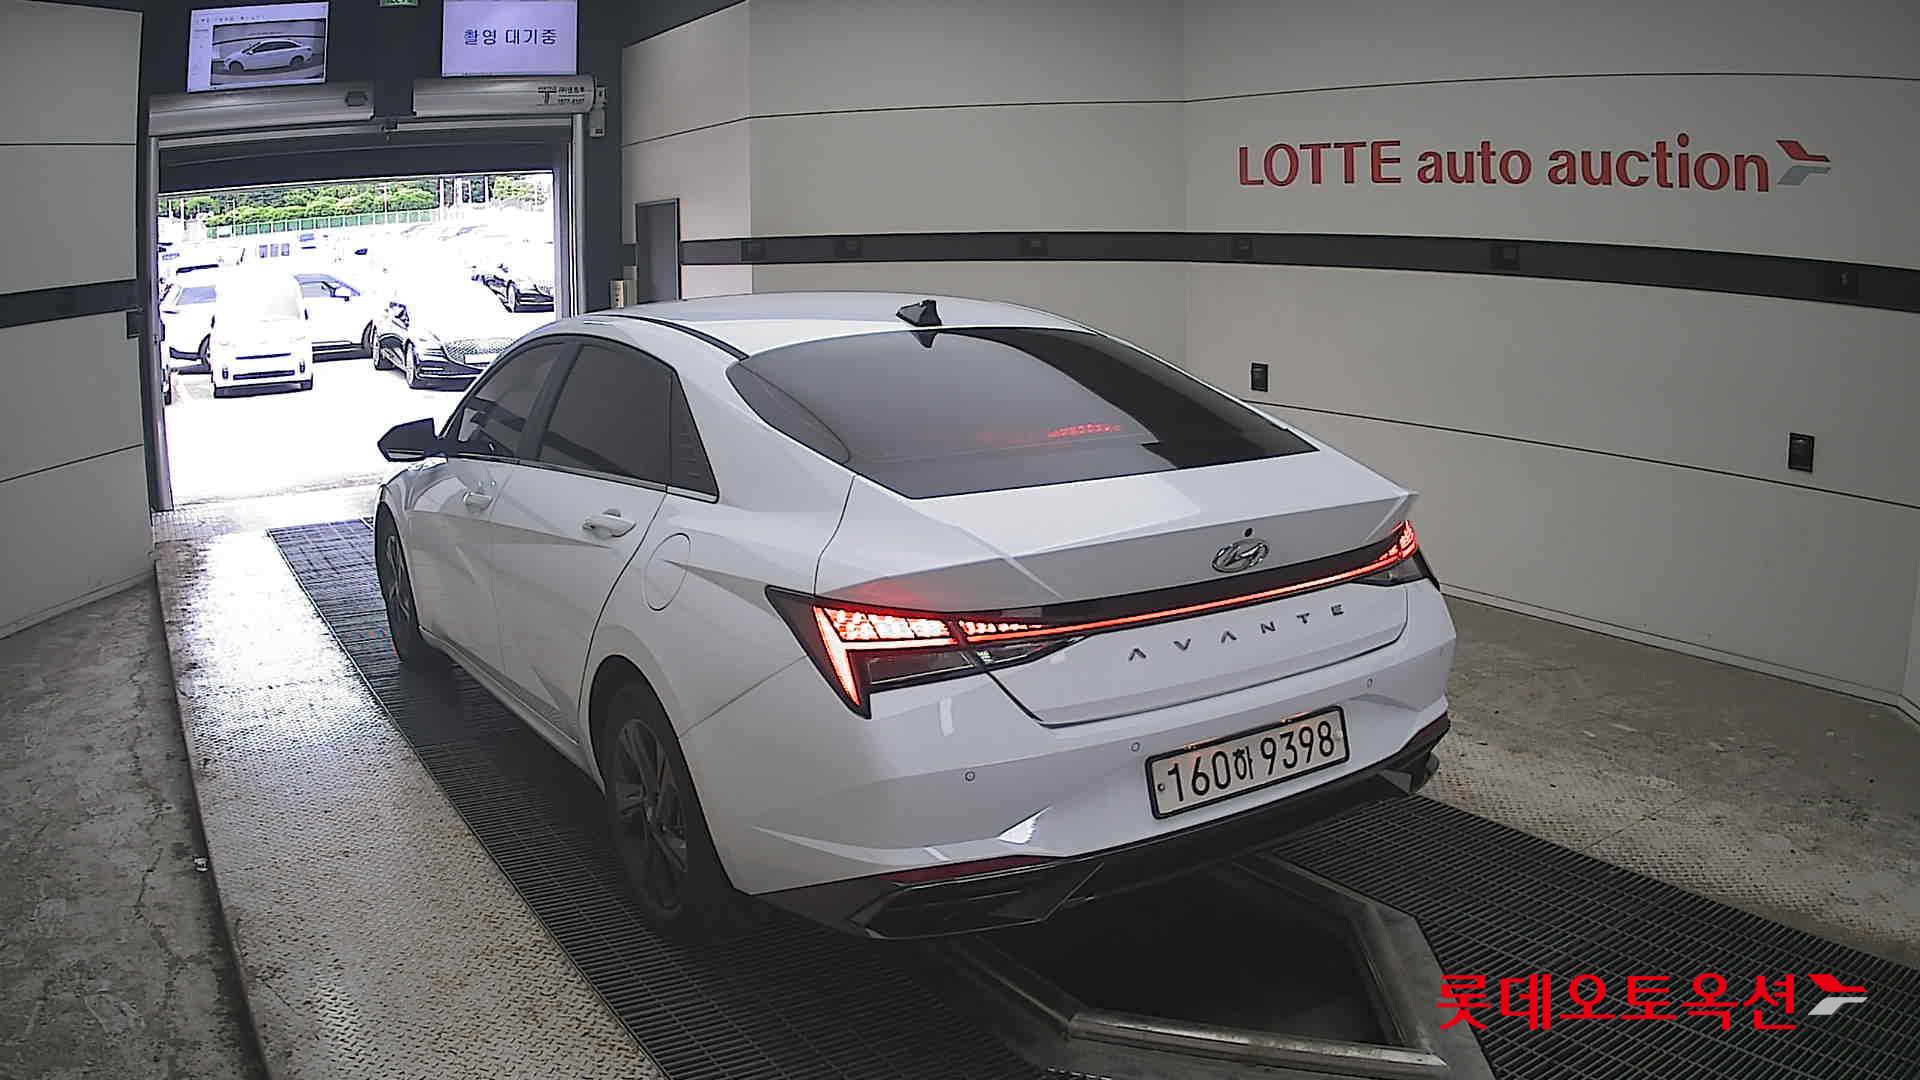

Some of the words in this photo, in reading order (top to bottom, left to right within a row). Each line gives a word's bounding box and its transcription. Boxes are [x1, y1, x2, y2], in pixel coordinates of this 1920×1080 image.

[464, 28, 497, 46] 촬영
[505, 28, 559, 46] 대기중
[1238, 140, 1401, 187] LOTTE
[1416, 140, 1533, 186] auto
[1547, 132, 1770, 192] auction
[1127, 603, 1345, 662] AVANTE
[1167, 746, 1255, 802] 160하
[1259, 720, 1335, 776] 9398
